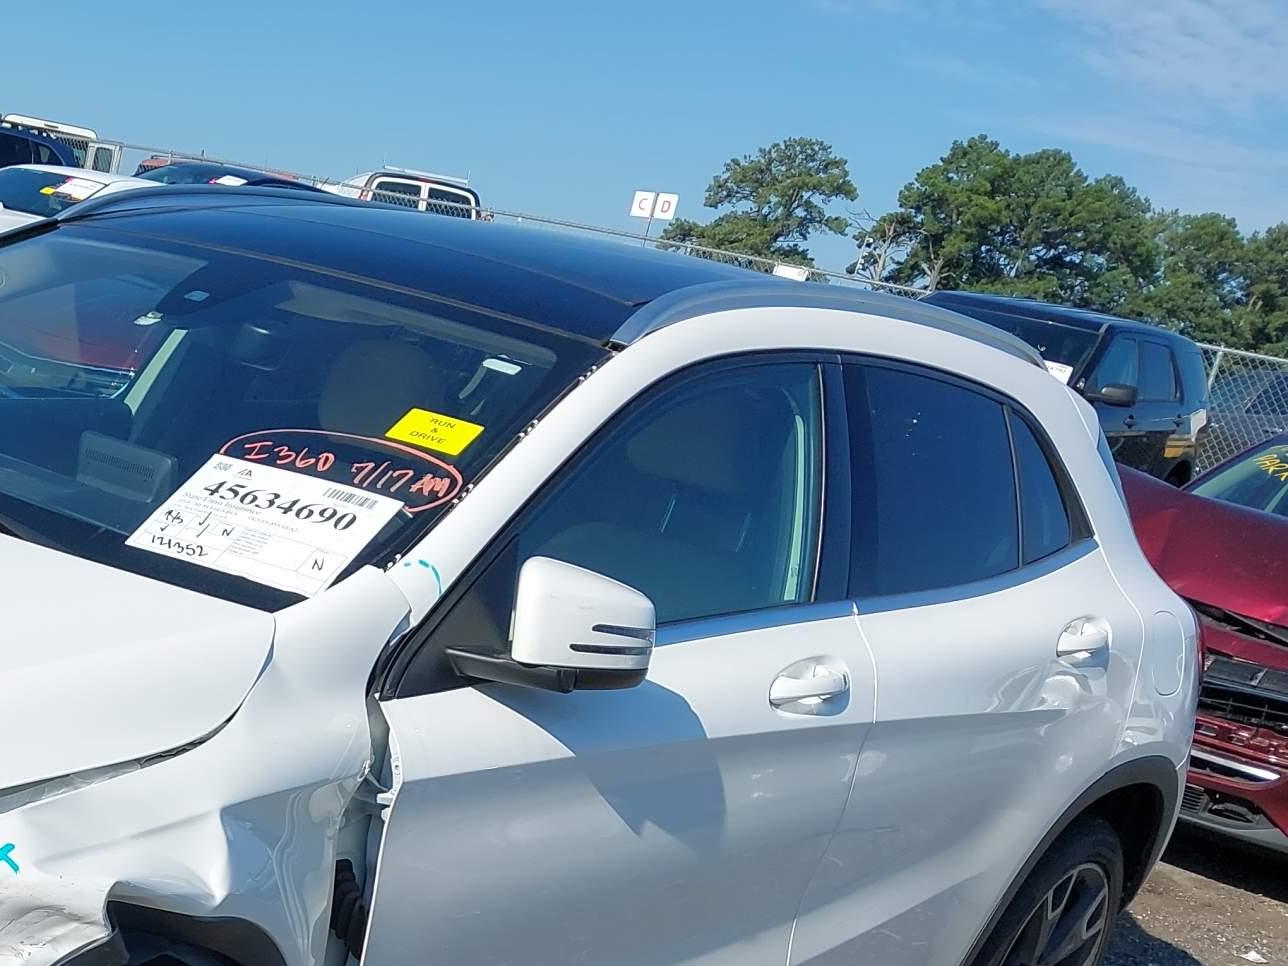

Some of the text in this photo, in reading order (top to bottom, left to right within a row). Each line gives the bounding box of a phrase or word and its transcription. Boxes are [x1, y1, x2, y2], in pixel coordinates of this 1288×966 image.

[638, 198, 672, 213] C D
[429, 417, 457, 429] RUN
[409, 430, 447, 445] DRIVE
[351, 460, 414, 493] 7/17
[203, 480, 357, 531] 45634690
